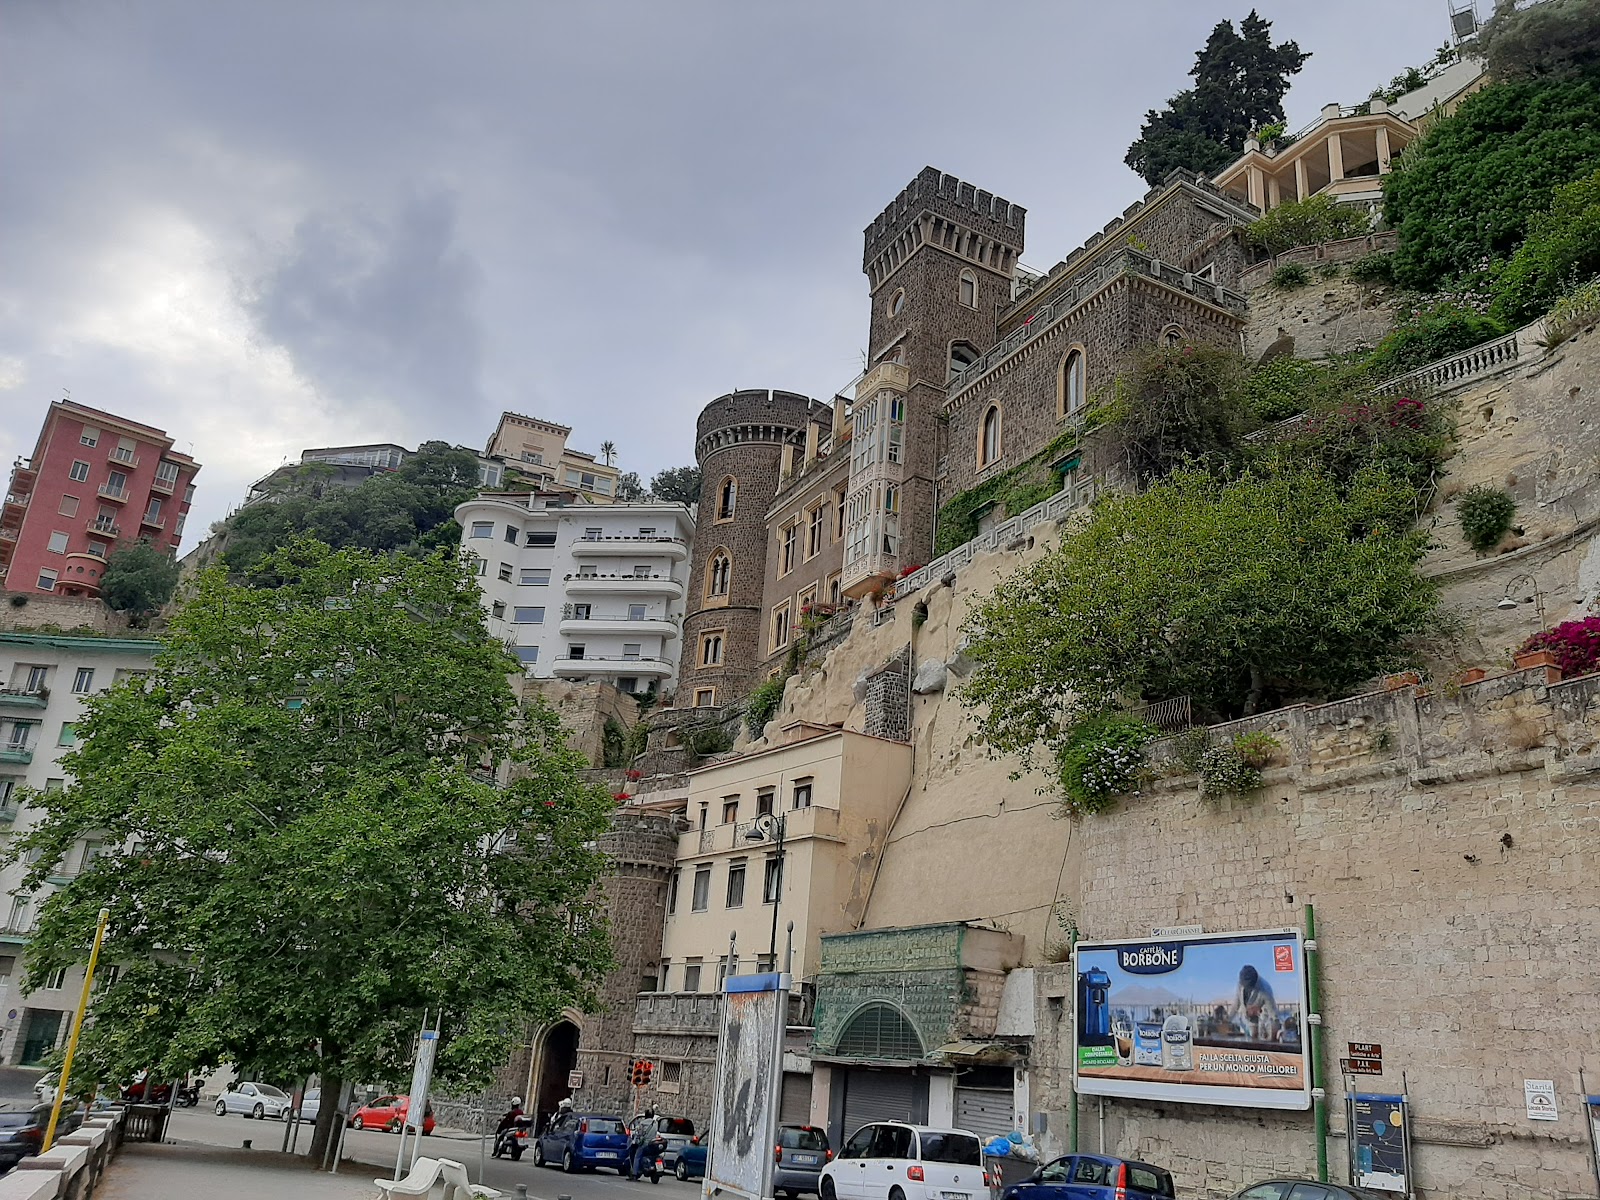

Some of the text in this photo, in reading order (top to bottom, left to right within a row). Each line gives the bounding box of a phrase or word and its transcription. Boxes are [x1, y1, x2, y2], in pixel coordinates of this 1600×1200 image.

[1123, 949, 1178, 967] BORBONE
[1199, 1053, 1270, 1063] FAI LA SCELTA GIUSTA
[1199, 1063, 1297, 1074] PER UN MONDO MIGLIORE!
[1526, 1081, 1552, 1090] Starita
